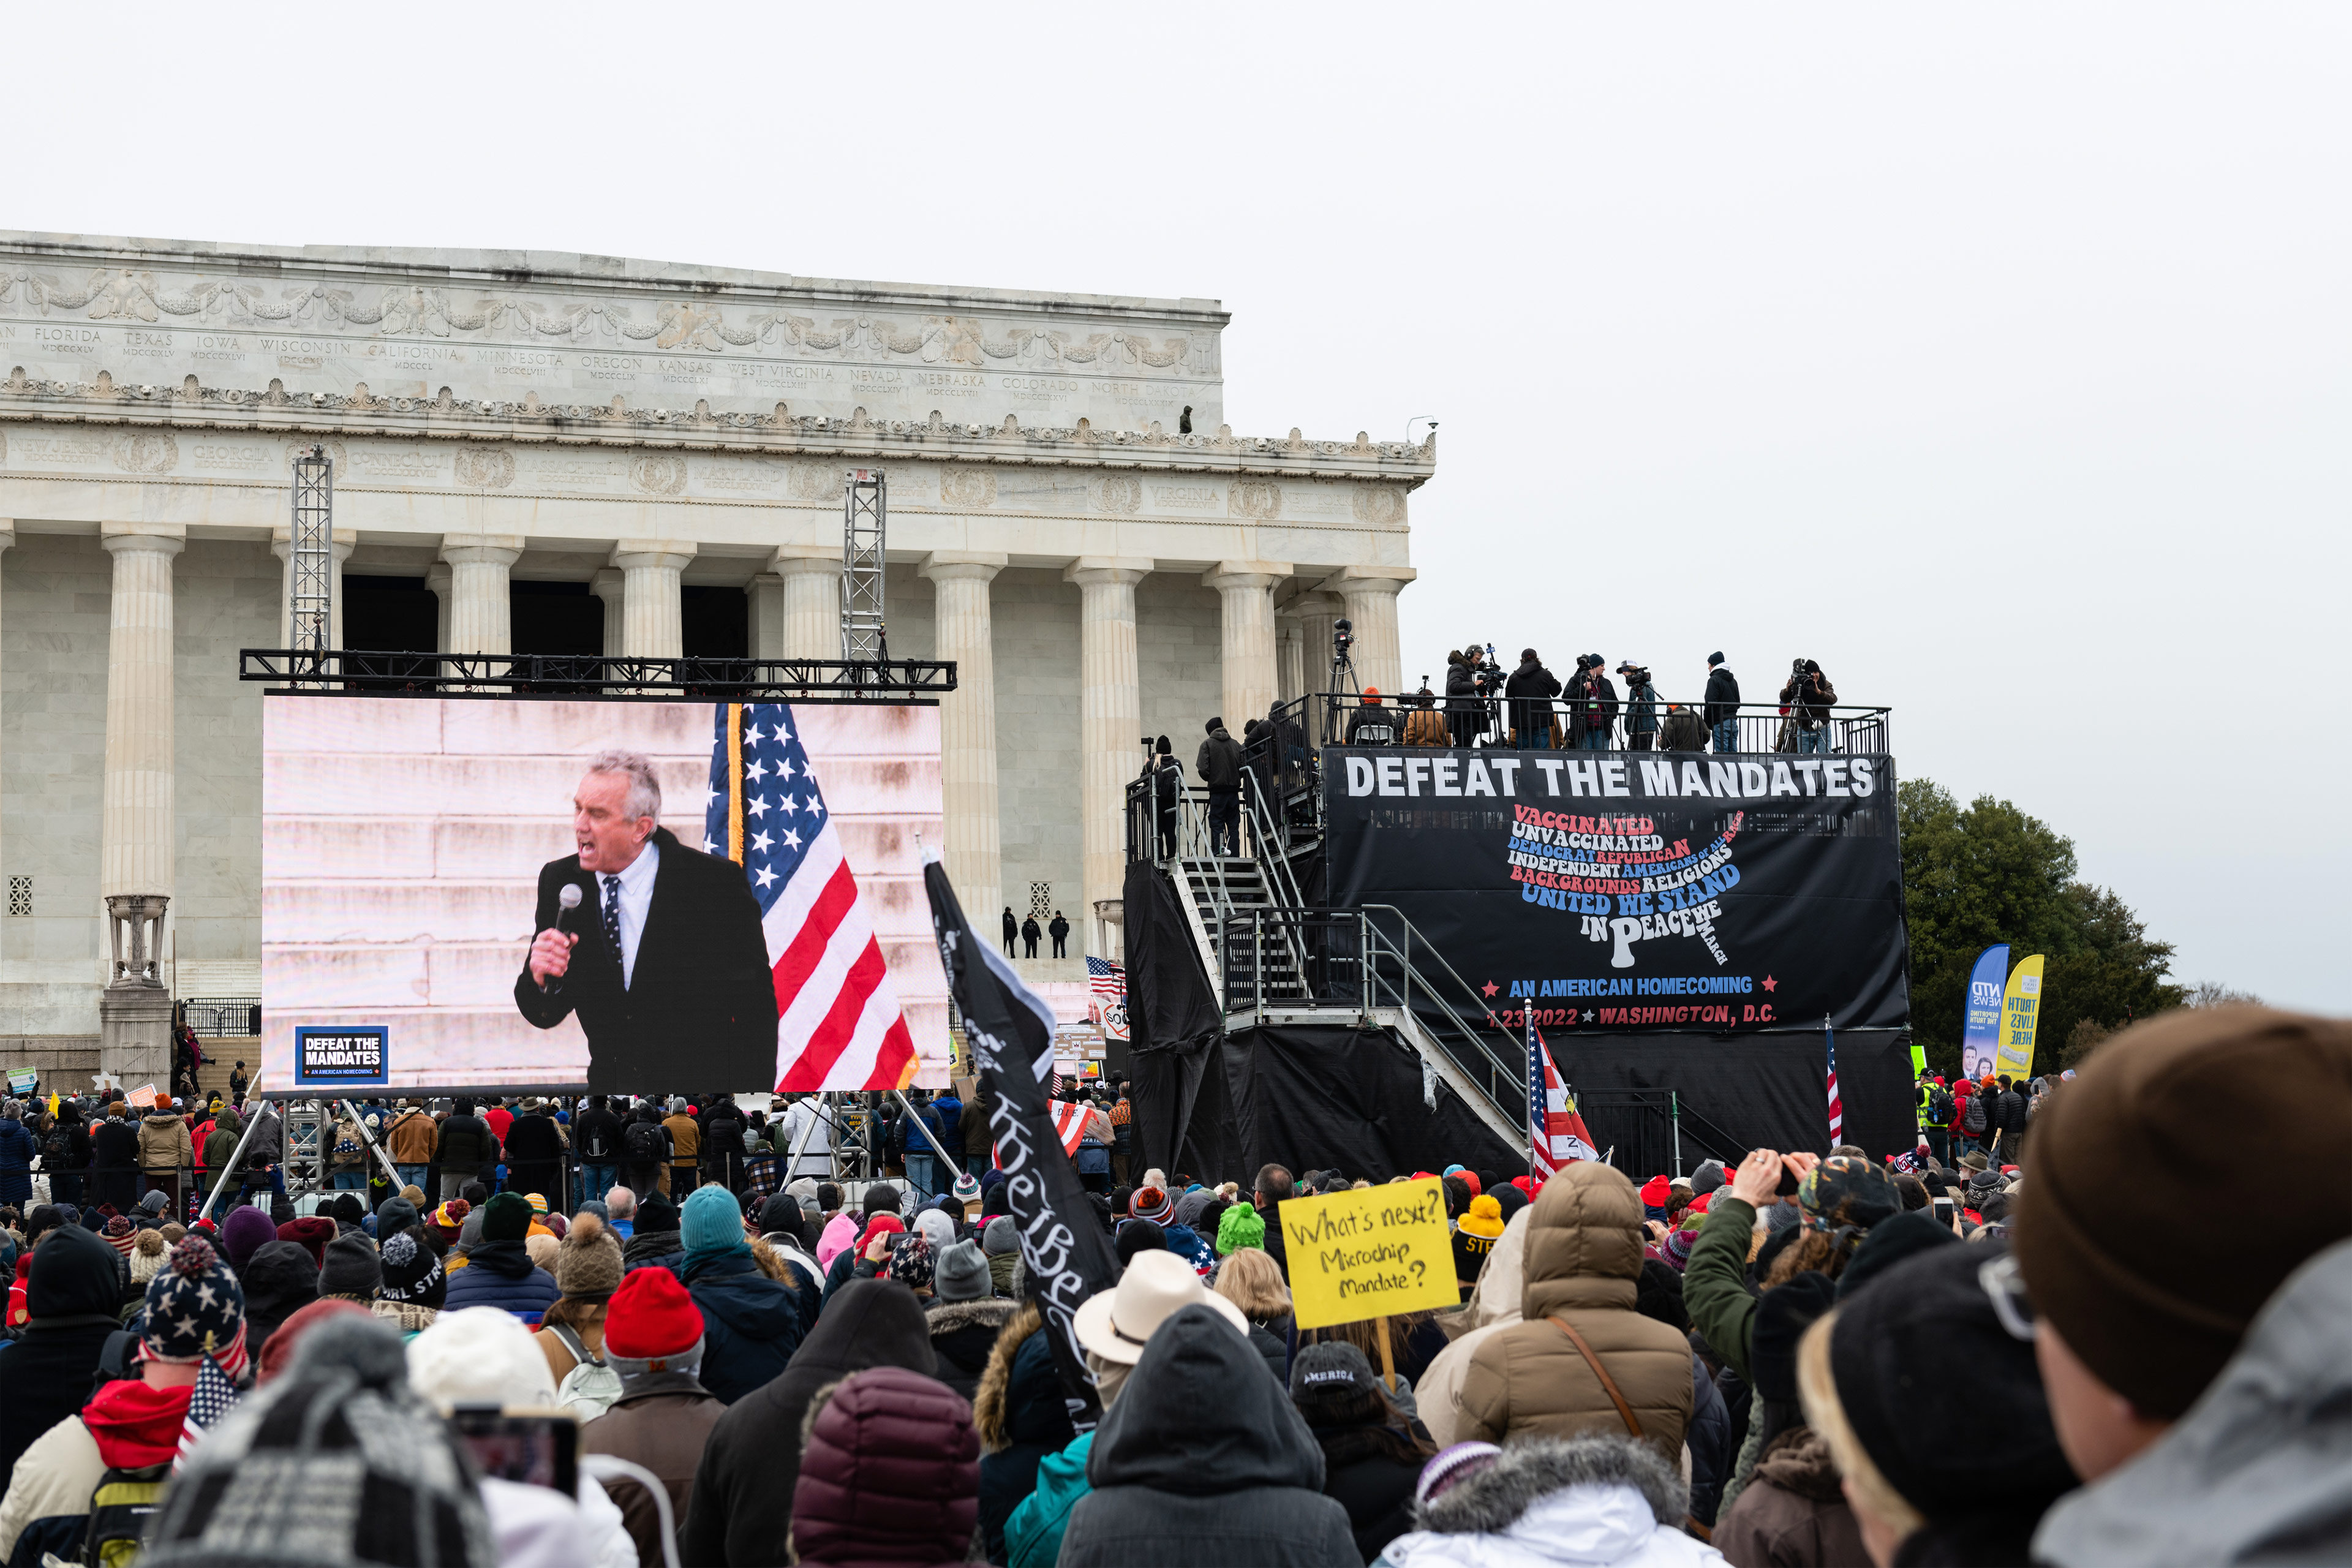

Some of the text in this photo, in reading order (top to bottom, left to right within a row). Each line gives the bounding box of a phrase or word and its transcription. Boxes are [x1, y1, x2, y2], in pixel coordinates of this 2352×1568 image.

[35, 328, 102, 343] FLORIDA
[123, 333, 173, 347] TEXAS
[197, 336, 241, 350] IOWA
[42, 344, 94, 353] MDCCCXLV
[123, 348, 175, 358] MDCCCXLV
[260, 339, 350, 354] WISCONSIN
[368, 345, 459, 360] CALIFORNIA
[190, 351, 246, 361] MDCCCXLVI
[477, 350, 565, 366] MINNESOTA
[581, 355, 643, 369] OREGON
[395, 361, 432, 371] MDCCCL
[495, 366, 546, 376] MDCCCLVIII
[658, 359, 712, 374] KANSAS
[728, 363, 834, 380] WEST VIRGINIA
[590, 371, 635, 381] MDCCCLIX
[663, 375, 709, 385] MDCCCLXI
[850, 370, 904, 383] NEVADA
[919, 373, 986, 388] NEBRASKA
[756, 379, 807, 389] MDCCCLXIII
[852, 385, 901, 393] MDCCCLXIV
[1002, 377, 1078, 391] COLORADO
[1092, 381, 1196, 398] NORTH DAKOTA
[926, 388, 978, 398] MDCCCLXVII
[1013, 392, 1067, 402] MDCCCLXXVI
[10, 438, 111, 455] NEW JERSEY
[192, 445, 273, 462] GEORGIA
[350, 451, 453, 469] CONNECTICUT
[694, 467, 783, 483] MARYLAND
[1149, 486, 1220, 501] VIRGINIA
[1345, 757, 1874, 798] DEFEAT THE MANDATES
[1514, 804, 1654, 836] VACCINATED
[1512, 820, 1664, 852] UNVACCINATED
[1507, 810, 1744, 878] INDEPENDENT AMERICANS OF ALL RACES
[1507, 836, 1691, 864] DEMOCRAT REPUBLICAN
[1510, 843, 1733, 894] BACKGROUNDS RELIGIONS
[1521, 864, 1741, 916] UNITED WE STAND
[1693, 899, 1722, 925] WE
[1580, 909, 1697, 968] IN PEACE
[1695, 921, 1728, 966] MARCH
[1509, 976, 1752, 998] AN AMERICAN HOMECOMING
[1599, 1005, 1736, 1028] WASHINGTON,
[1743, 1003, 1777, 1022] D.C.
[306, 1038, 379, 1050] DEFEAT THE
[306, 1051, 380, 1066] MANDATES
[1899, 1153, 1914, 1175] USA
[1289, 1189, 1439, 1246] What's next?
[1320, 1243, 1410, 1273] Microchip
[1303, 1370, 1355, 1385] AMERICA
